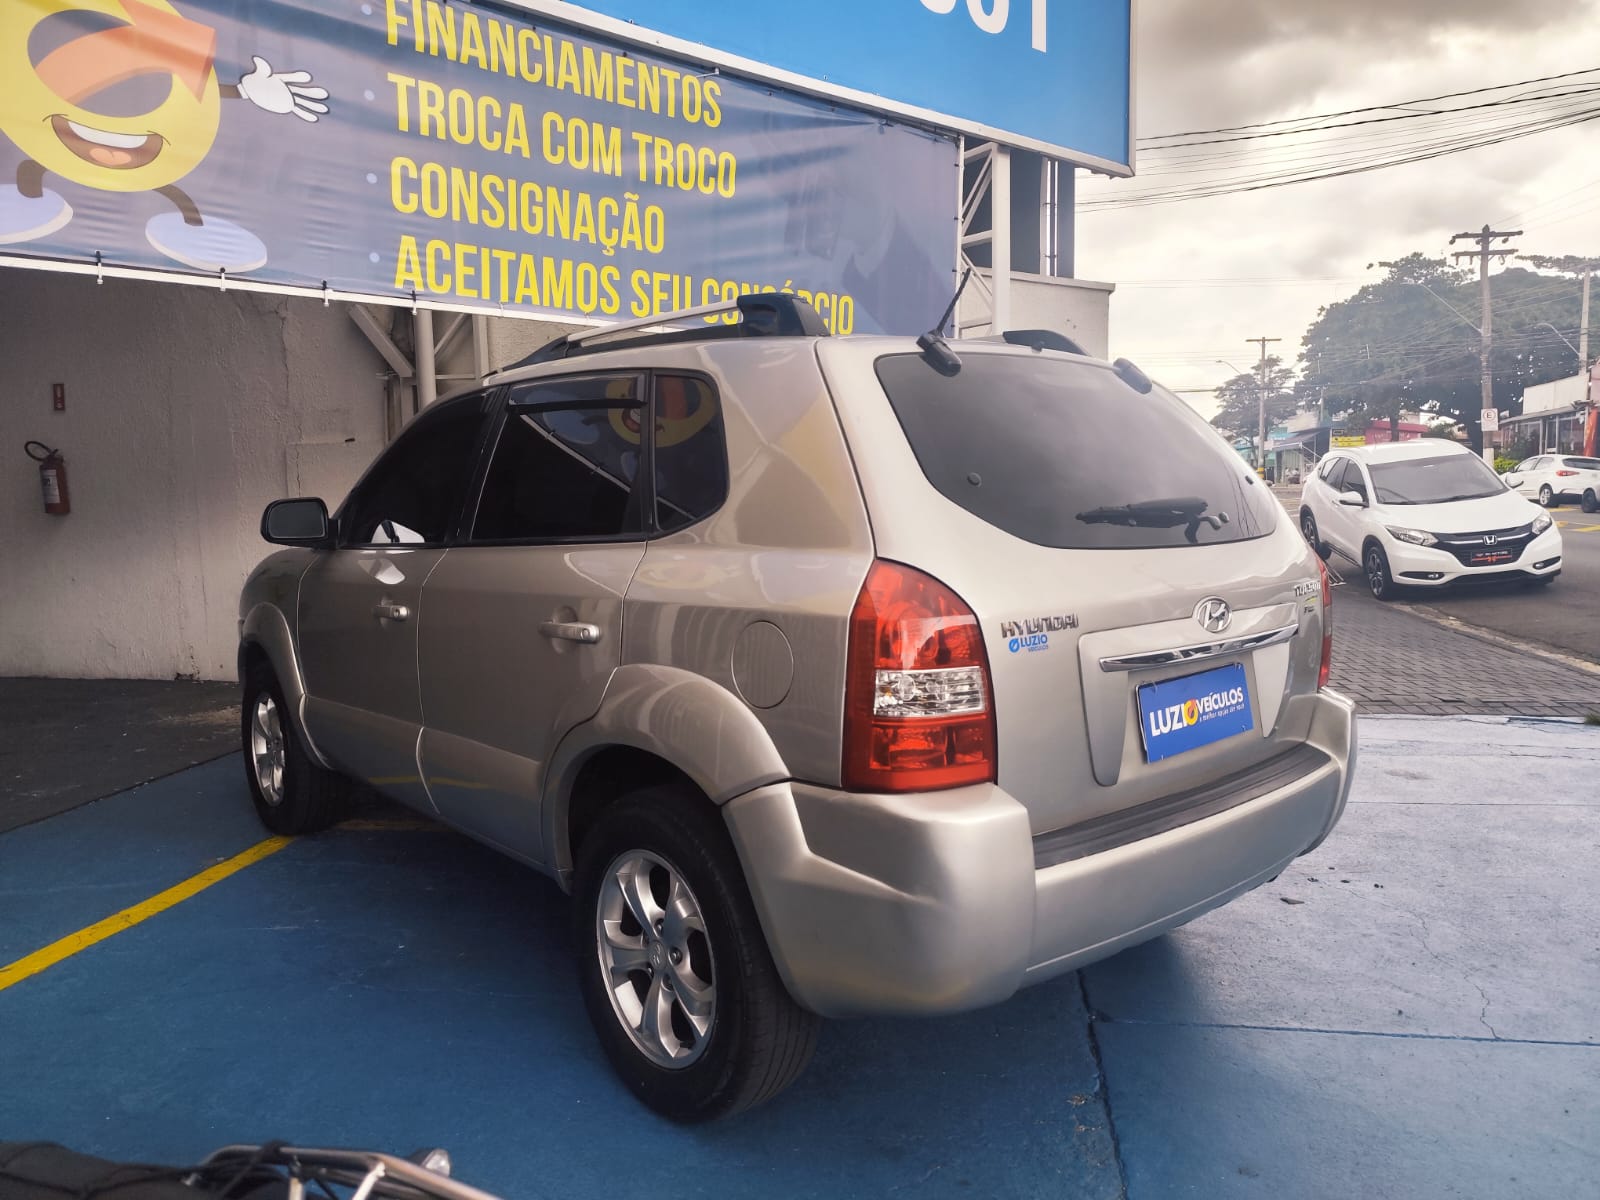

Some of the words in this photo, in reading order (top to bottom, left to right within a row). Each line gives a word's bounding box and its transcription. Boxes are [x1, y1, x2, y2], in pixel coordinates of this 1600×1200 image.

[385, 0, 722, 128] FINANCIAMENTOS
[387, 72, 531, 159] TROCA
[542, 111, 622, 177] COM
[631, 131, 737, 199] TROCO
[390, 156, 665, 256] CONSIGNAÇÃO
[394, 235, 621, 315] ACEITAMOS
[630, 269, 692, 318] SEU
[1000, 612, 1079, 639] HYUNDAI
[1020, 634, 1048, 648] LUZIO
[1149, 699, 1199, 737] LUZIO
[1195, 686, 1244, 714] VEÍCULOS
